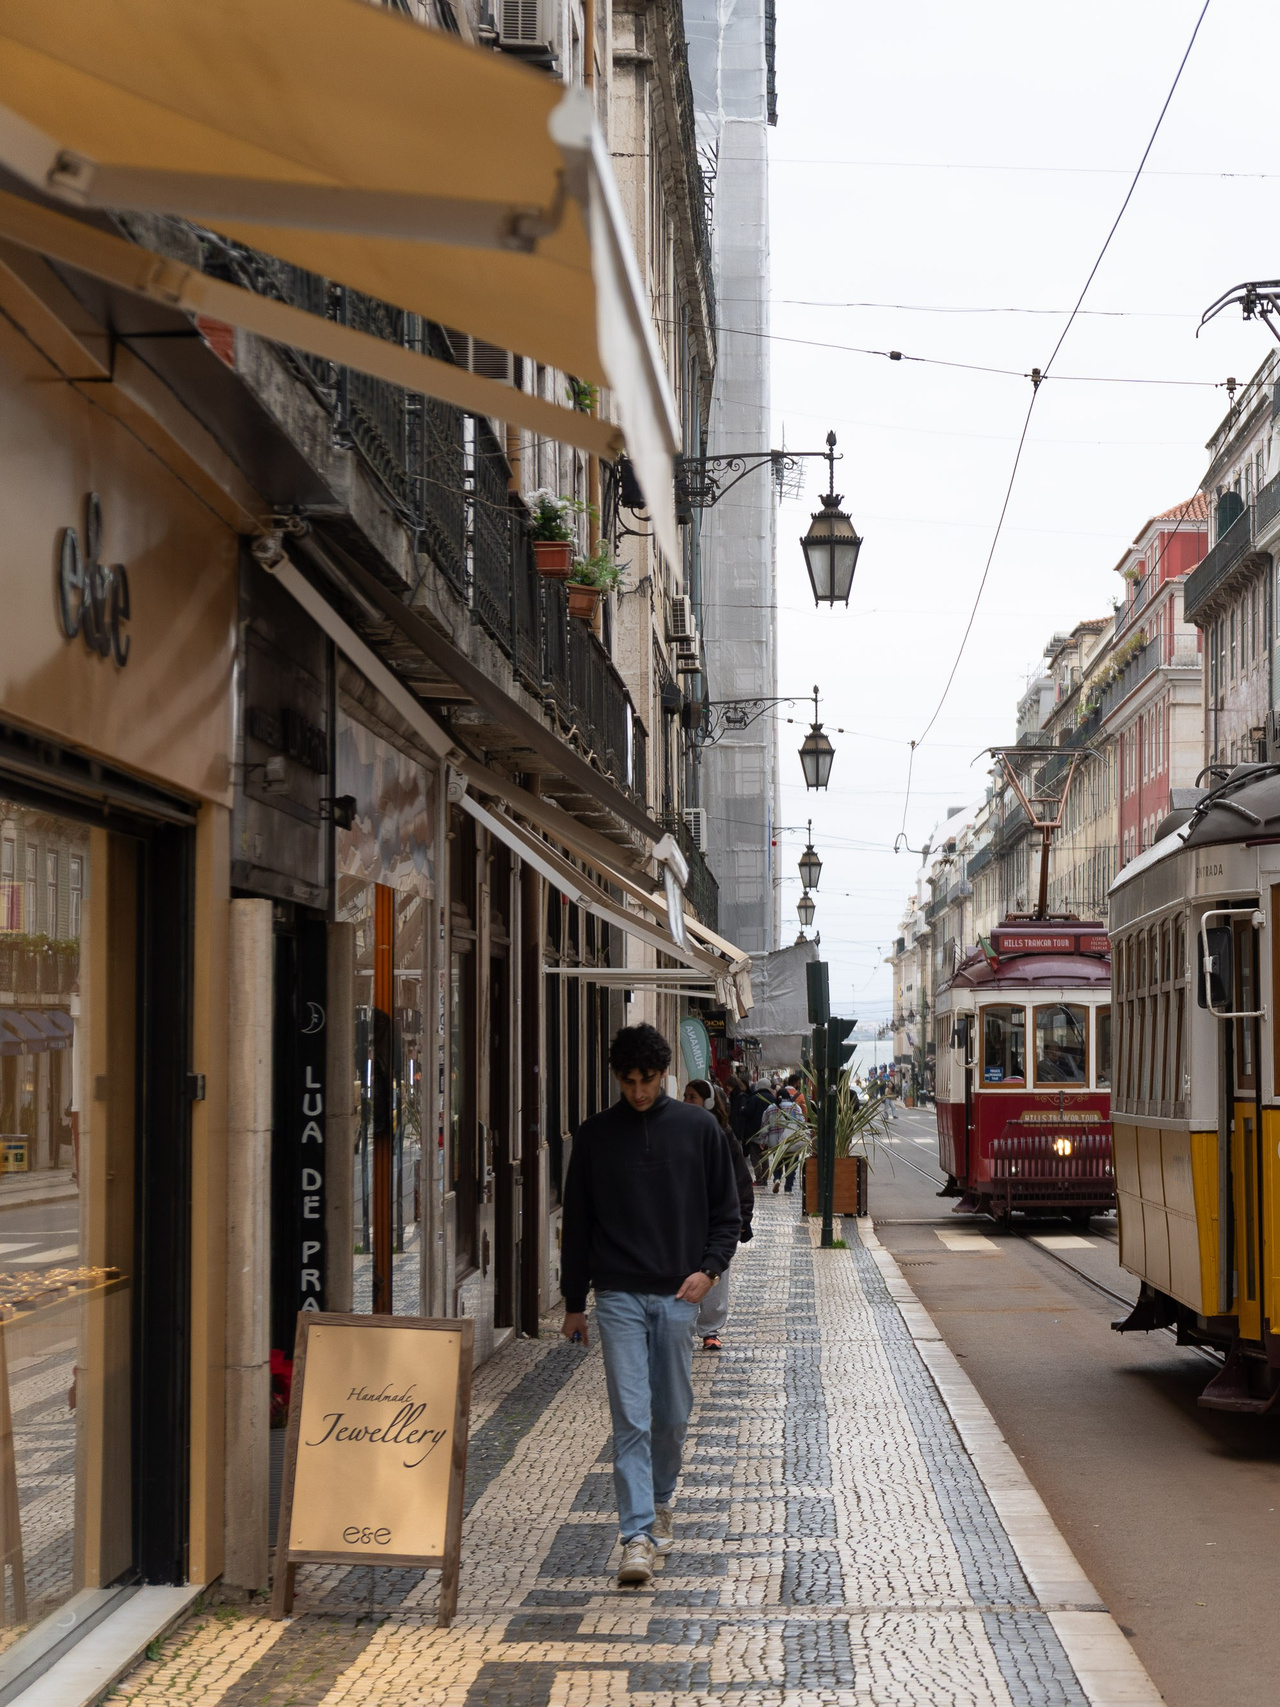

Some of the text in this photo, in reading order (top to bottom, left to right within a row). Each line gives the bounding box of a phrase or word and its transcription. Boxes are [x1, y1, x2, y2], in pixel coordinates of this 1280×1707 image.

[1196, 863, 1224, 879] ENTRADA
[1004, 939, 1023, 947] HILLS
[1053, 939, 1070, 947] TOUR
[301, 1065, 323, 1143] LUA
[301, 1168, 323, 1219] DE
[346, 1383, 417, 1403] Handmade
[305, 1402, 447, 1468] Jewellery
[342, 1526, 391, 1545] e&e
